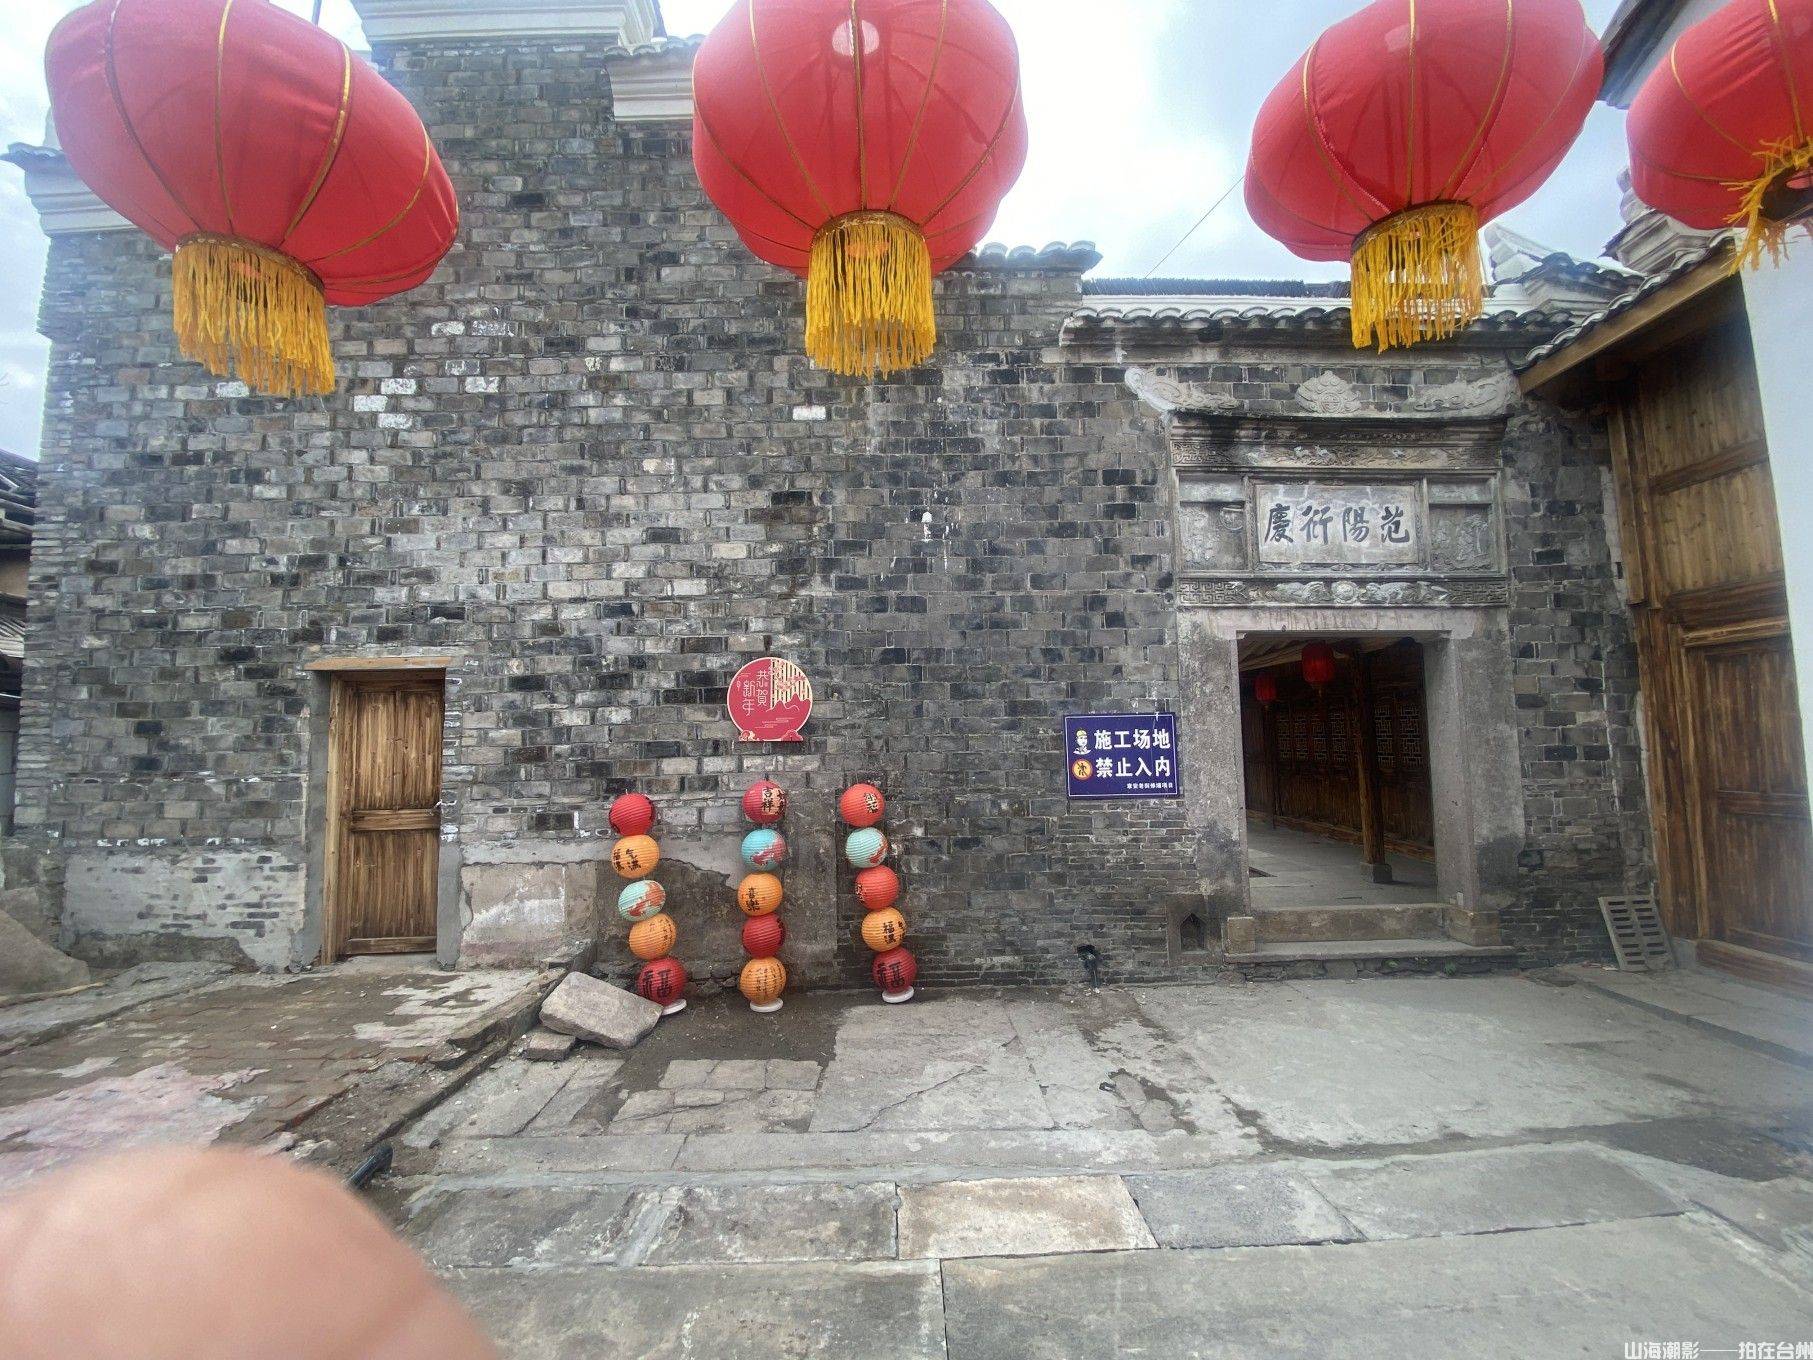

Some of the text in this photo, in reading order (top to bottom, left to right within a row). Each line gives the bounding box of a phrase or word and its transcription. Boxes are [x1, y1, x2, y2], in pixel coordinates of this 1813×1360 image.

[1093, 728, 1171, 750] 施工场地
[1095, 756, 1171, 779] 禁止入内
